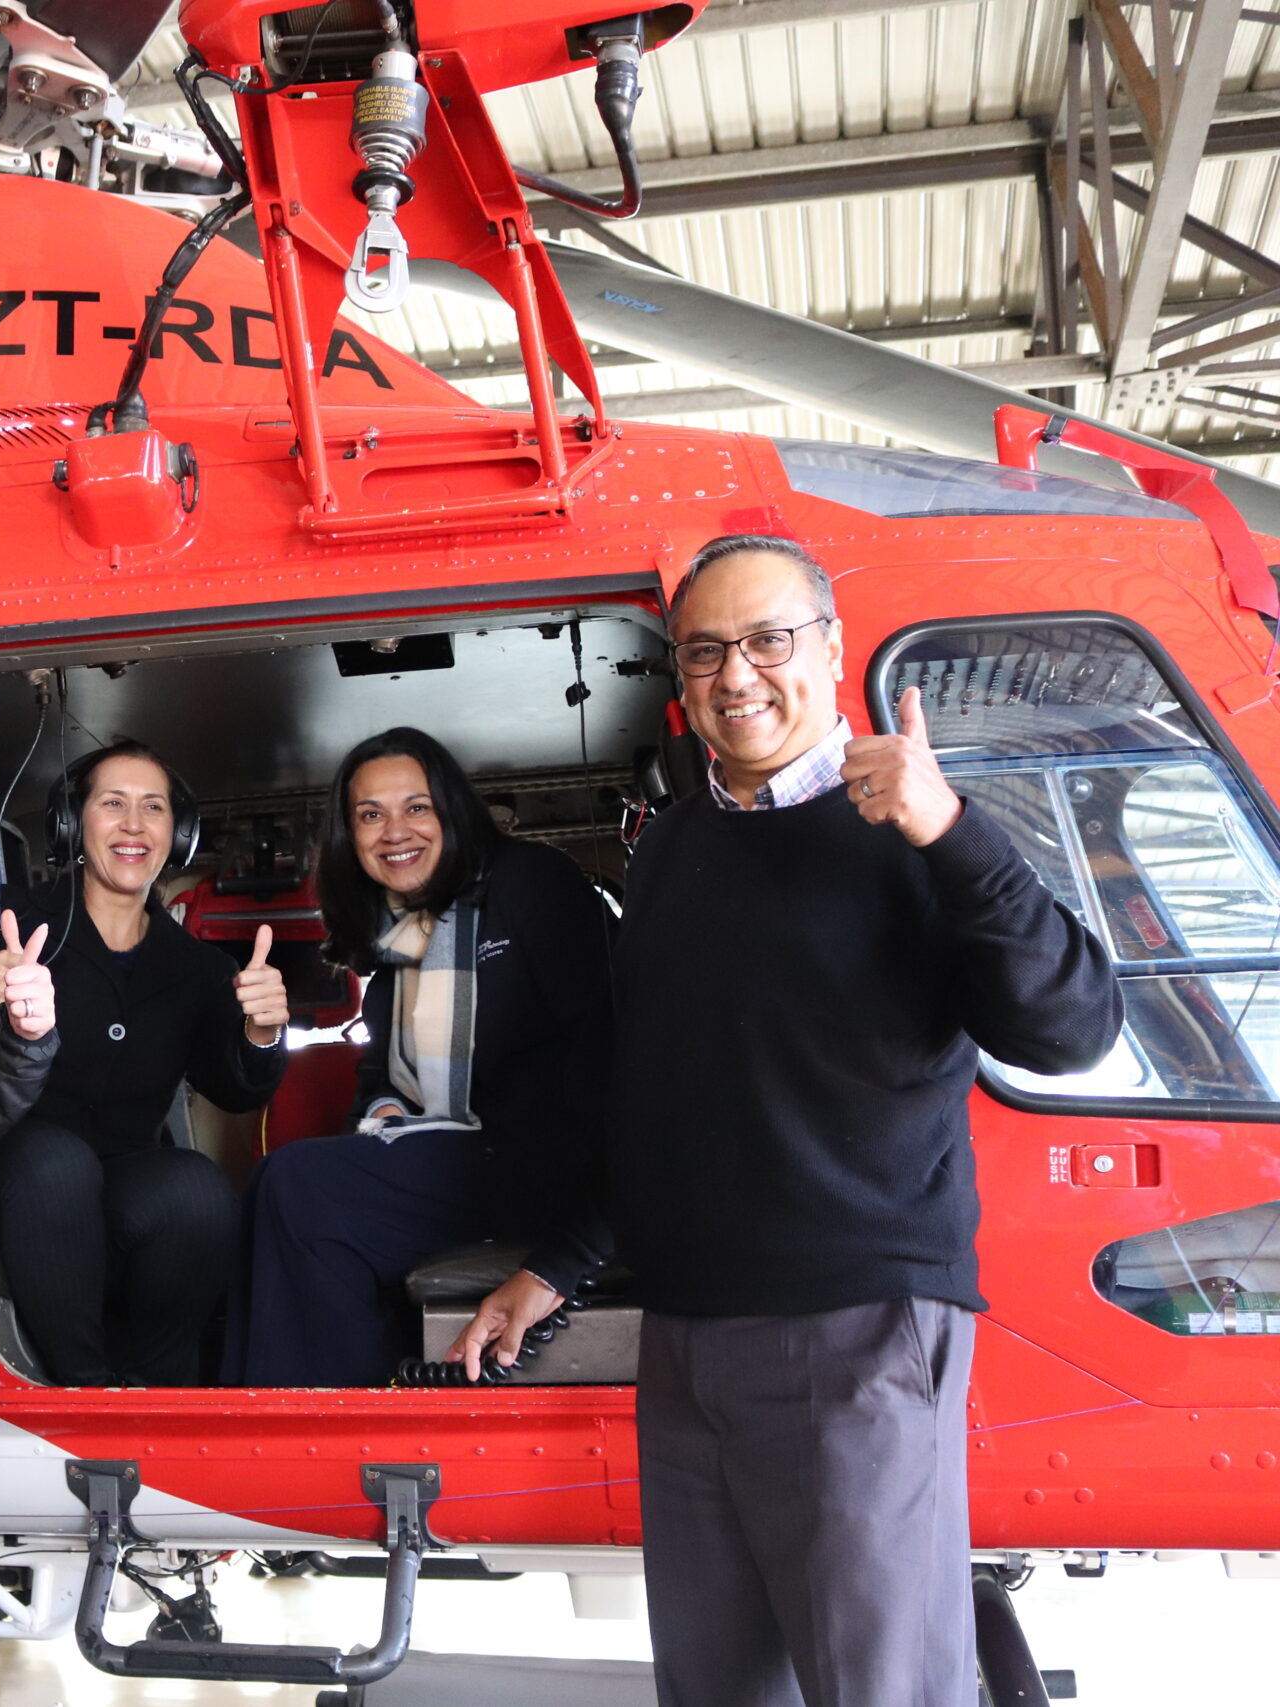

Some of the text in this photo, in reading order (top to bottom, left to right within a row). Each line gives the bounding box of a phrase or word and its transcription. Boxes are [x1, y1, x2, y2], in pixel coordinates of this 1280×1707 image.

[391, 93, 409, 102] DAILY
[1049, 1146, 1059, 1183] PUSH
[1059, 1148, 1068, 1182] PULL
